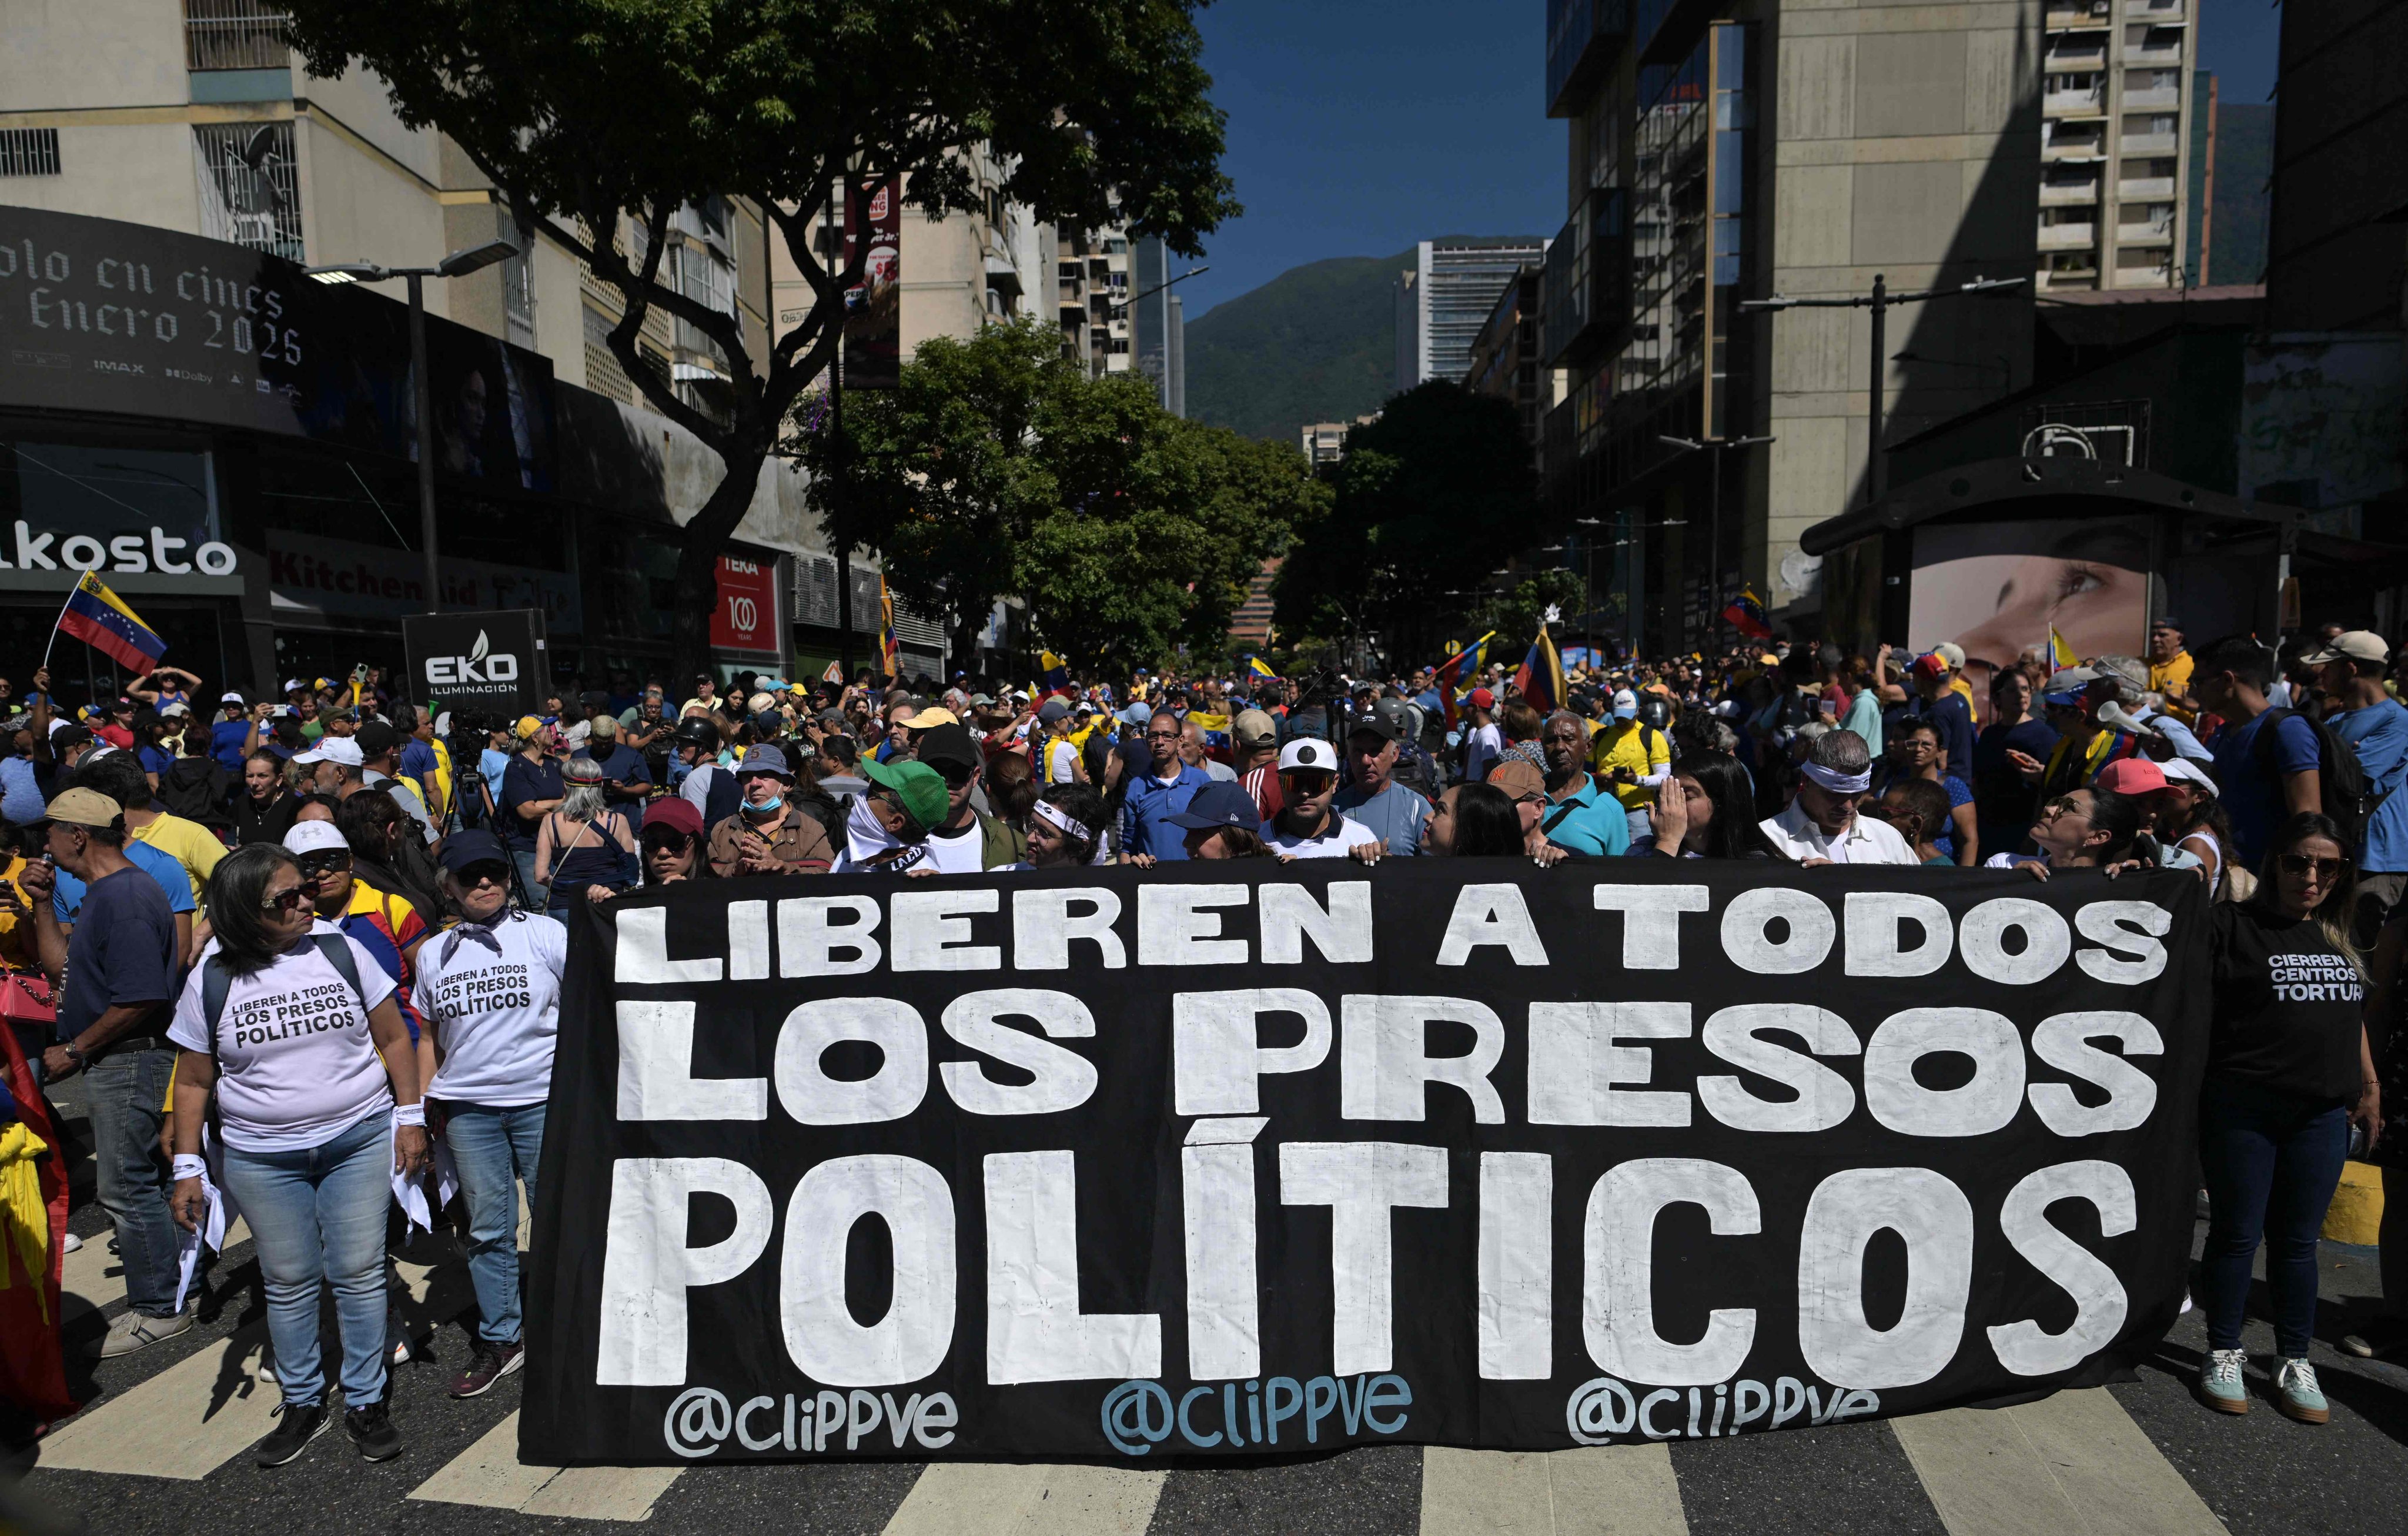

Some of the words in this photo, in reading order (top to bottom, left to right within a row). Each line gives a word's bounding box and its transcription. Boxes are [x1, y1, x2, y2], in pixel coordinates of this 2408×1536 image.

[96, 257, 157, 295] en
[176, 265, 283, 321] cines
[29, 286, 179, 343] Enero
[94, 360, 145, 374] IMAX
[182, 370, 213, 384] Dolby
[0, 520, 237, 575] kosto
[725, 557, 759, 576] TEKA
[728, 595, 757, 632] 100
[426, 652, 518, 684] EKO
[430, 683, 518, 695] ILUMINACIÓN
[758, 700, 772, 711] VIGOR
[750, 747, 761, 759] 5
[615, 881, 1373, 983] LIBEREN
[1436, 884, 1549, 965] A
[1594, 884, 2172, 985] TODOS
[2268, 954, 2346, 968] CIERREN
[2271, 968, 2357, 982] CENTROS
[436, 970, 477, 989] LIBEREN
[481, 968, 488, 978] A
[491, 965, 527, 976] TODOS
[436, 985, 460, 1004] LOS
[466, 976, 528, 995] PRESOS
[232, 993, 287, 1015] LIBEREN
[292, 992, 300, 1002] A
[302, 983, 345, 999] TODOS
[235, 1010, 270, 1028] LOS
[276, 995, 348, 1020] PRESOS
[437, 992, 530, 1022] POLÍTICOS
[236, 1010, 354, 1049] POLÍTICOS
[616, 988, 1098, 1125] LOS
[1173, 988, 2164, 1136] PRESOS
[596, 1117, 2136, 1390] POLÍTICOS
